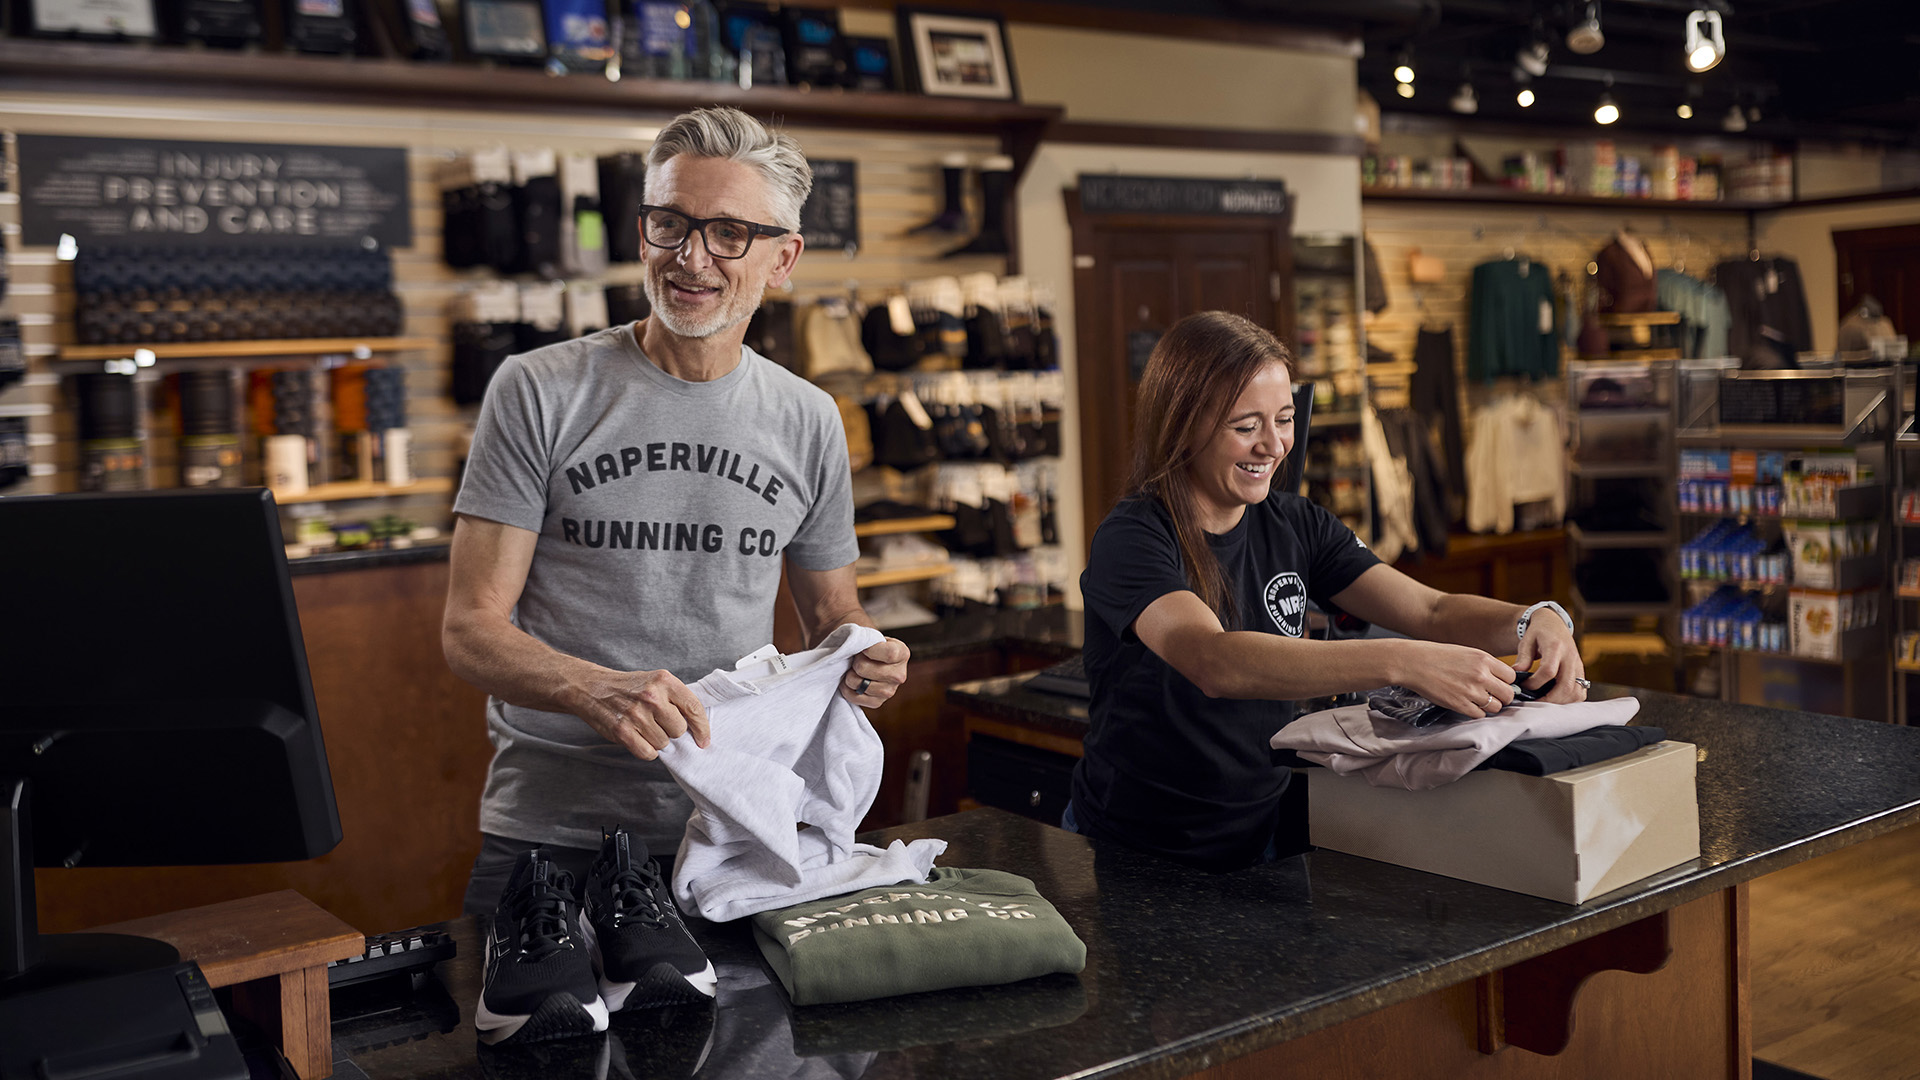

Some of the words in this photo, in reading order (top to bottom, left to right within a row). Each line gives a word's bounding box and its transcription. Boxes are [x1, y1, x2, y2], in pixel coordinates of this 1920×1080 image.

[159, 150, 283, 180] INJURY
[102, 175, 341, 208] PREVENTION
[129, 205, 209, 234] AND
[217, 205, 319, 235] CARE
[565, 442, 785, 506] NAPERVILLE
[561, 517, 724, 553] RUNNING
[1278, 595, 1301, 616] NR
